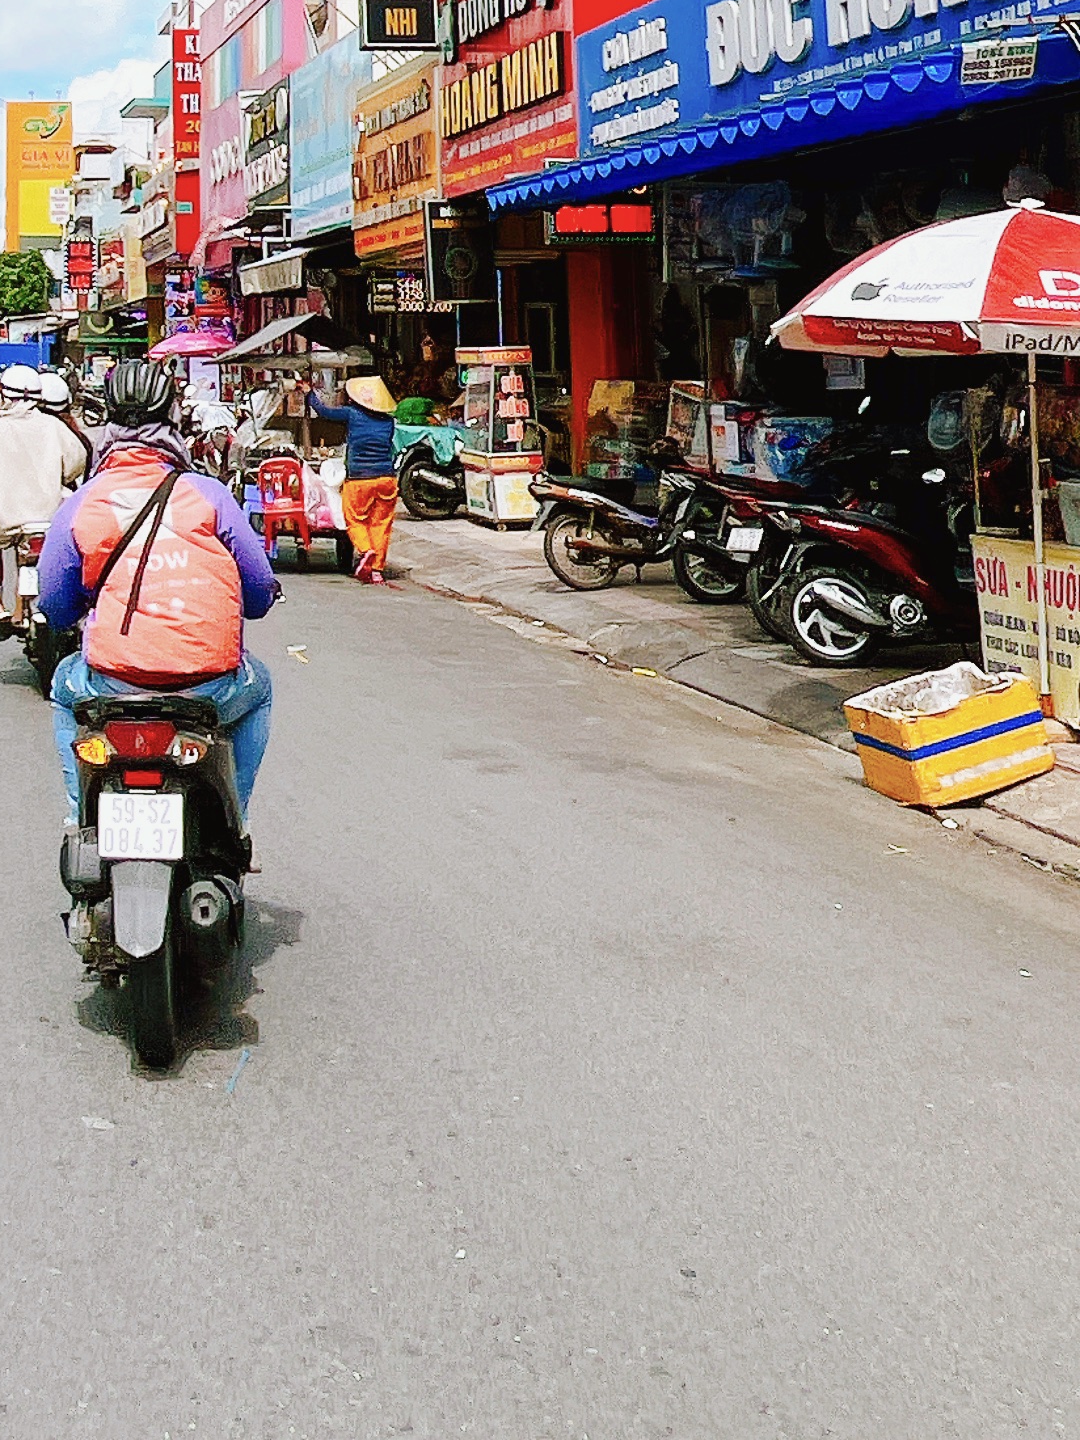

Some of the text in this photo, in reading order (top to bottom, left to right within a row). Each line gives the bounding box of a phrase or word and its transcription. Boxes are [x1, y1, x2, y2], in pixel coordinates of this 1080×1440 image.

[385, 8, 418, 36] NHI
[501, 31, 559, 112] MINH
[22, 151, 48, 161] GIA
[893, 276, 976, 292] Authorised
[883, 293, 945, 305] Reseller
[111, 797, 171, 825] 59-S2
